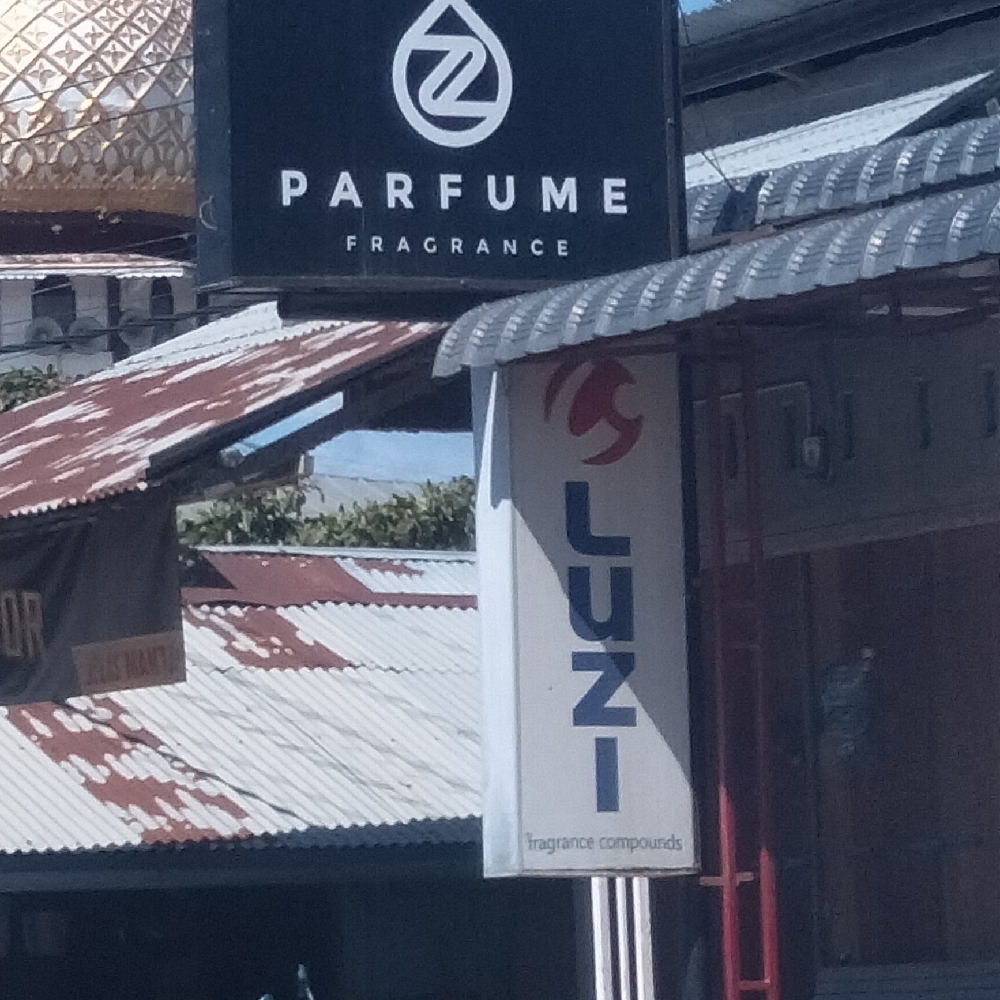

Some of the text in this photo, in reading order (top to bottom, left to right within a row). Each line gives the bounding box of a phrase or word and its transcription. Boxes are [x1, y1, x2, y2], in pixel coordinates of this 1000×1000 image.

[280, 169, 628, 214] PARFUME
[345, 234, 569, 257] FRAGRANCE
[599, 834, 684, 854] compounds
